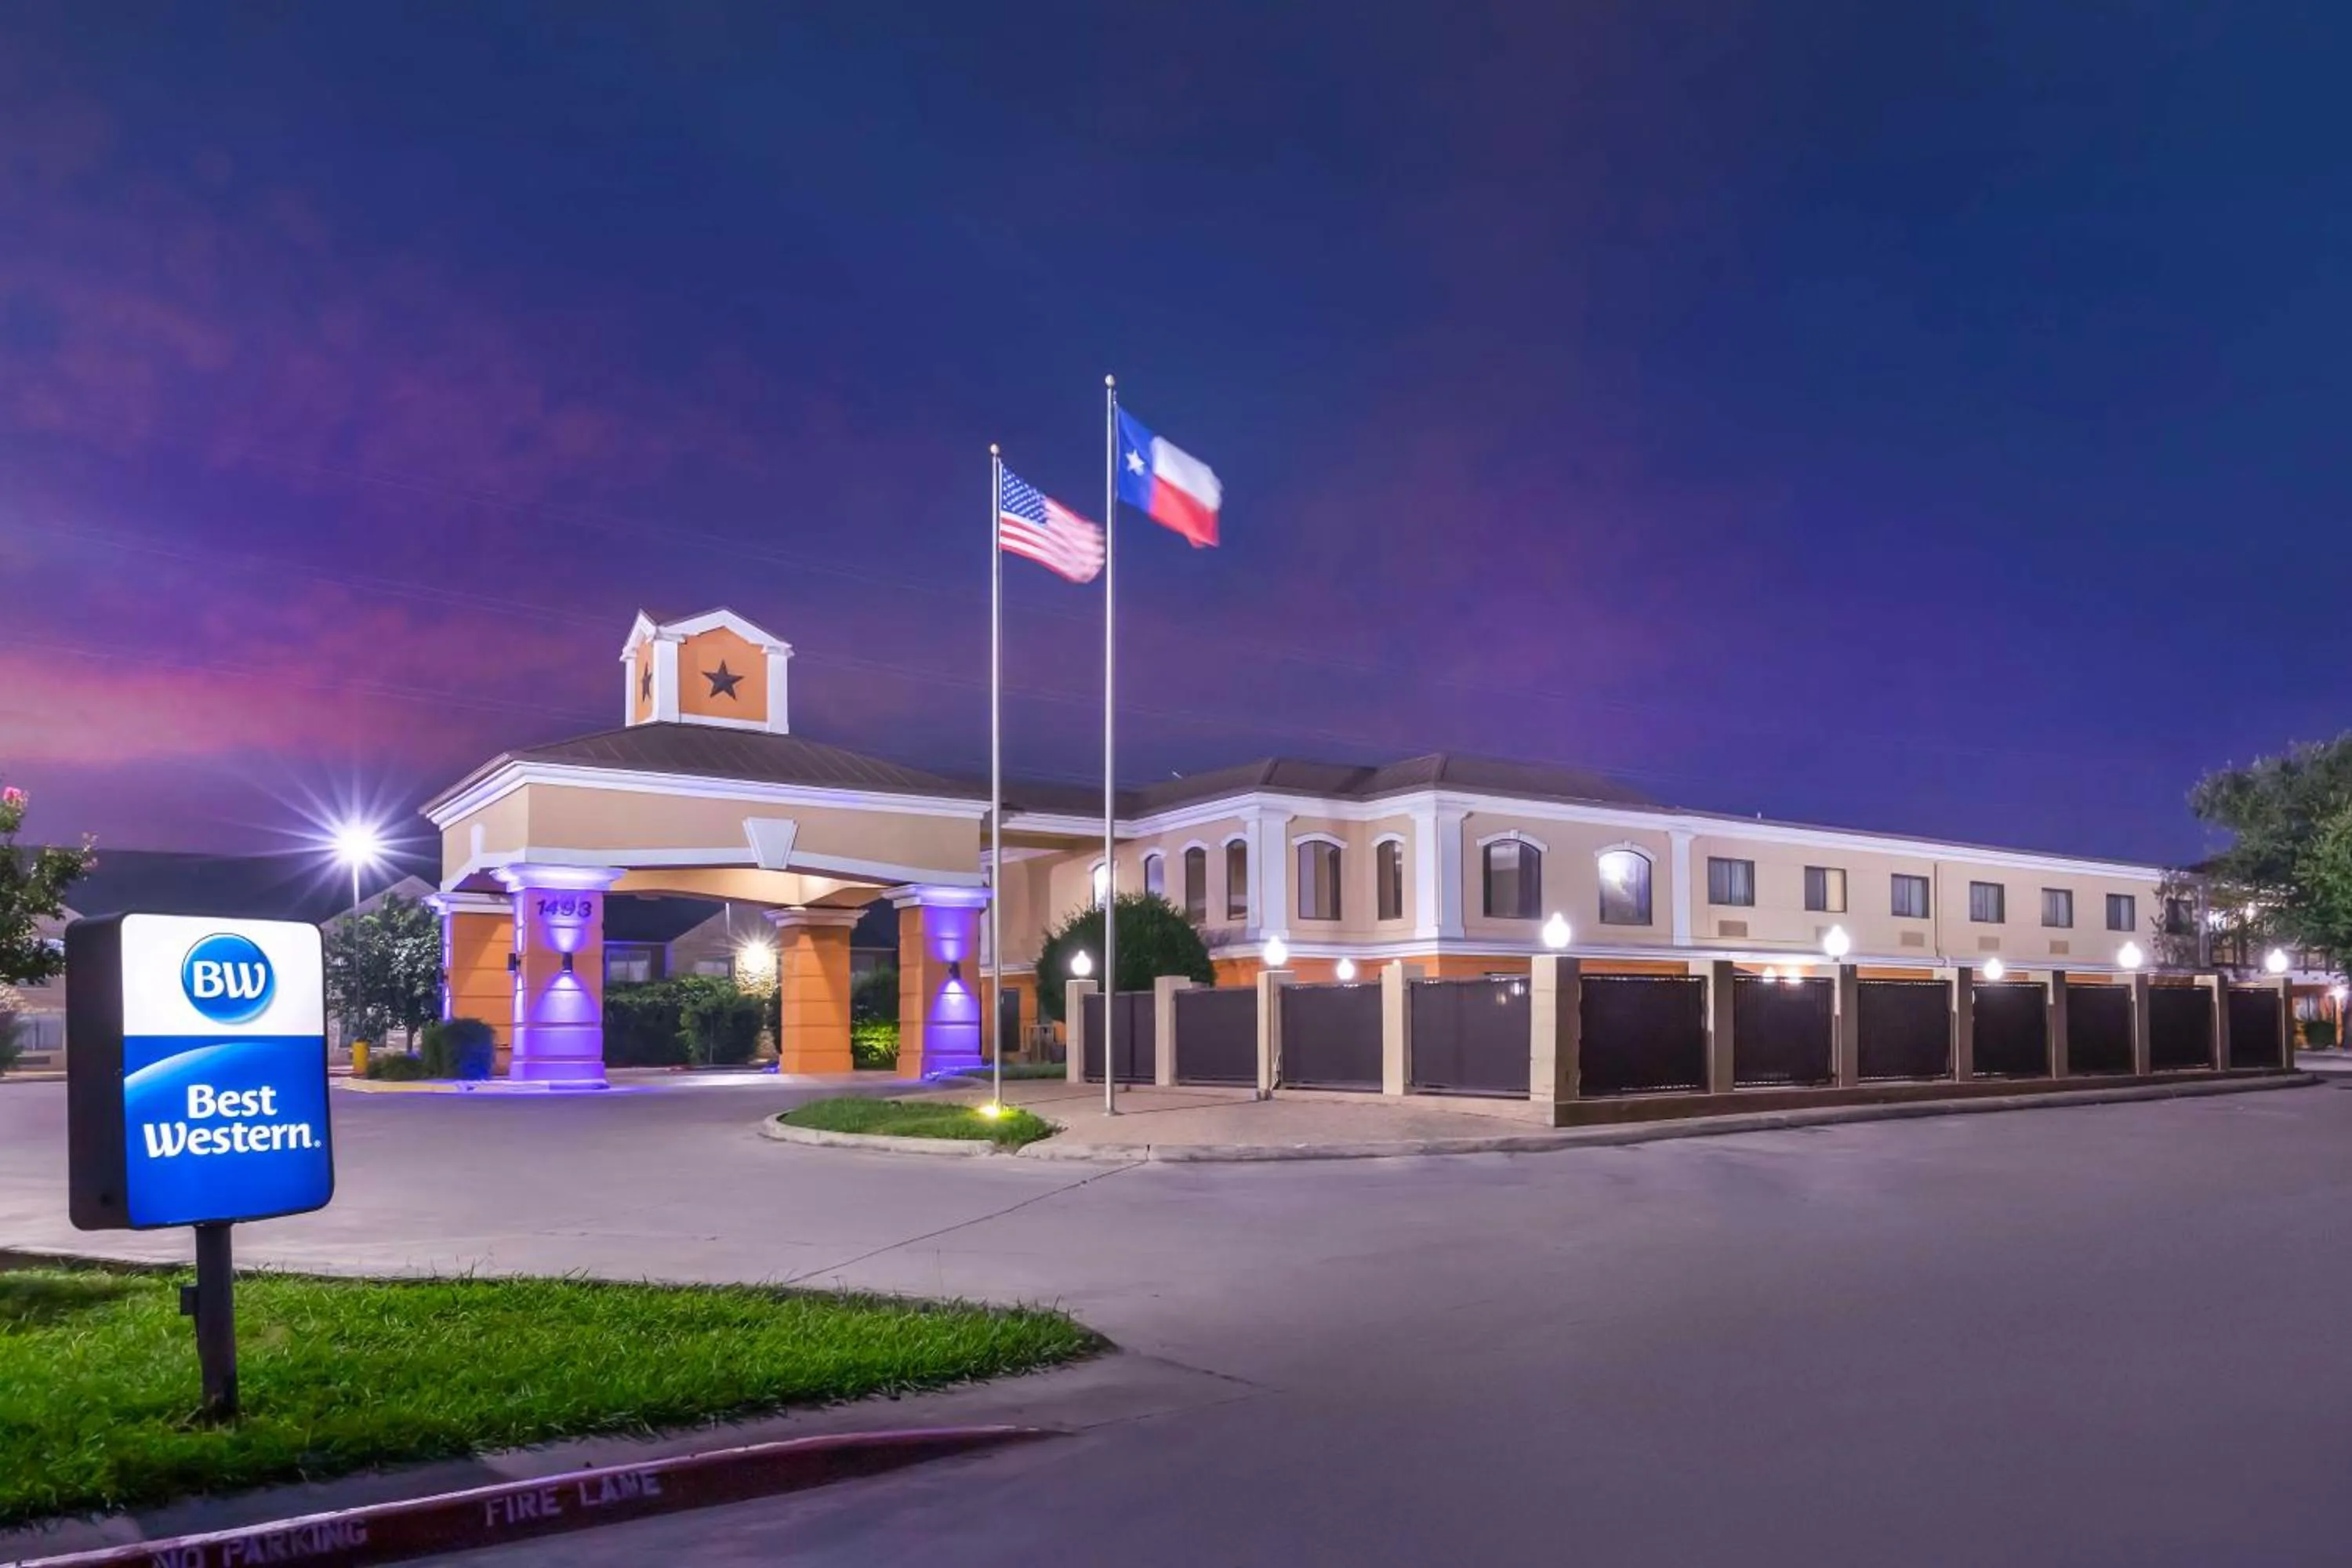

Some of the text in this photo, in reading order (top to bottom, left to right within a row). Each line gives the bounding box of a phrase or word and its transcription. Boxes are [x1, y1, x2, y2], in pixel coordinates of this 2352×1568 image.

[536, 899, 592, 918] 1493
[193, 960, 266, 1000] BW
[187, 1084, 278, 1119] Best
[485, 1469, 661, 1527] FIRE LANE
[152, 1519, 368, 1568] NO PARKING
